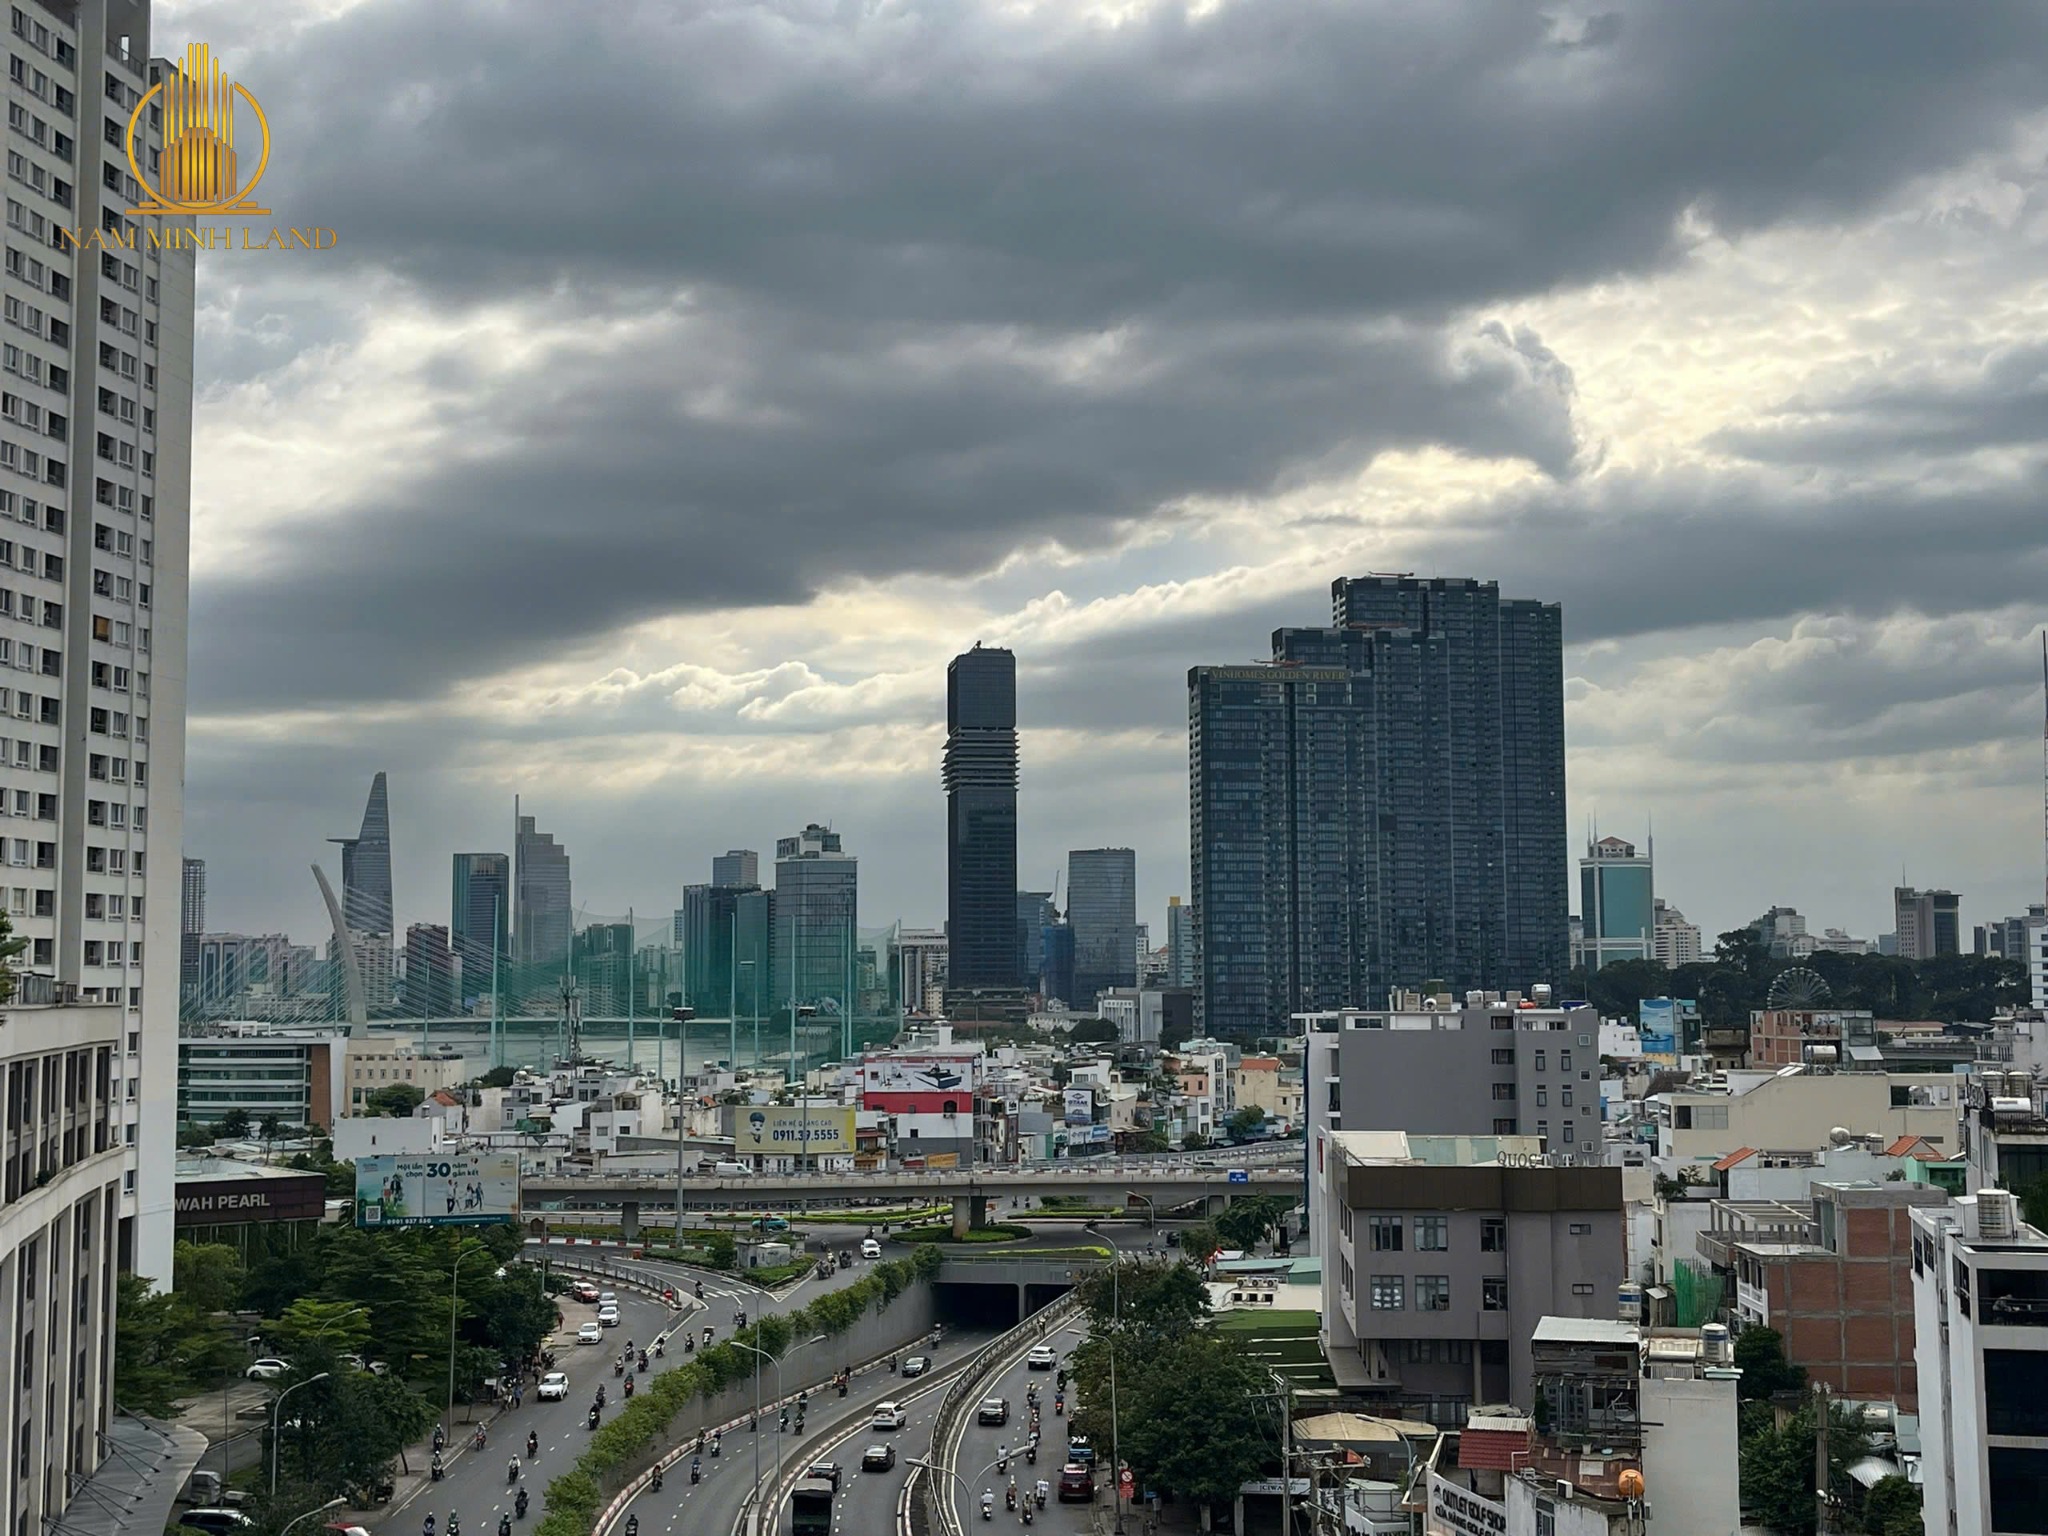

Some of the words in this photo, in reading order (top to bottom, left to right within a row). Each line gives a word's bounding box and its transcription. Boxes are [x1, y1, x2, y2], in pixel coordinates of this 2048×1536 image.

[1211, 670, 1265, 680] VINHOMES
[1266, 670, 1309, 680] GOLDEN
[1312, 670, 1346, 680] RIVER
[426, 1162, 451, 1178] 30
[175, 1196, 212, 1211] WAH
[218, 1193, 270, 1209] PEARL
[1443, 1488, 1468, 1516] OUTLET
[1469, 1501, 1486, 1525] GOLF
[1487, 1509, 1507, 1533] SHOP
